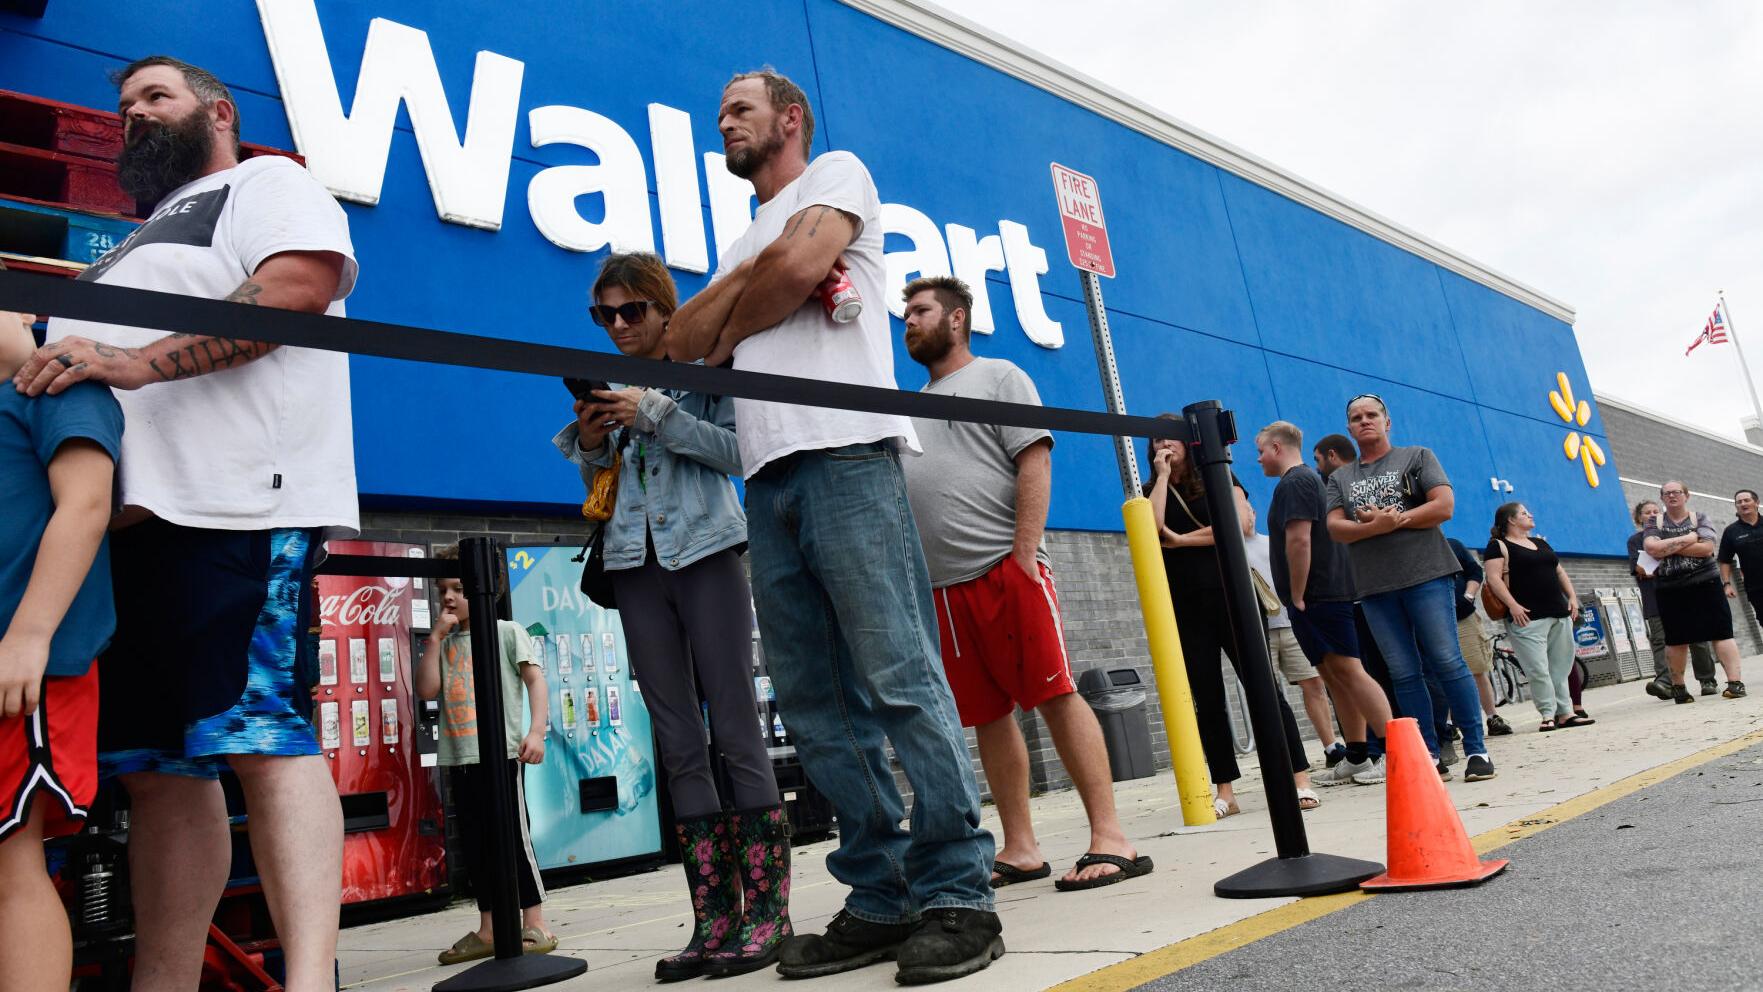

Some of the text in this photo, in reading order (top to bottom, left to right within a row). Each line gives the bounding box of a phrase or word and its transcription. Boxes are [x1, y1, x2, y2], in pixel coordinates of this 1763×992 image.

[258, 0, 1064, 349] Walart
[1062, 171, 1091, 199] FIRE
[1064, 196, 1098, 224] LANE
[509, 550, 536, 571] $2
[542, 579, 587, 618] DAS
